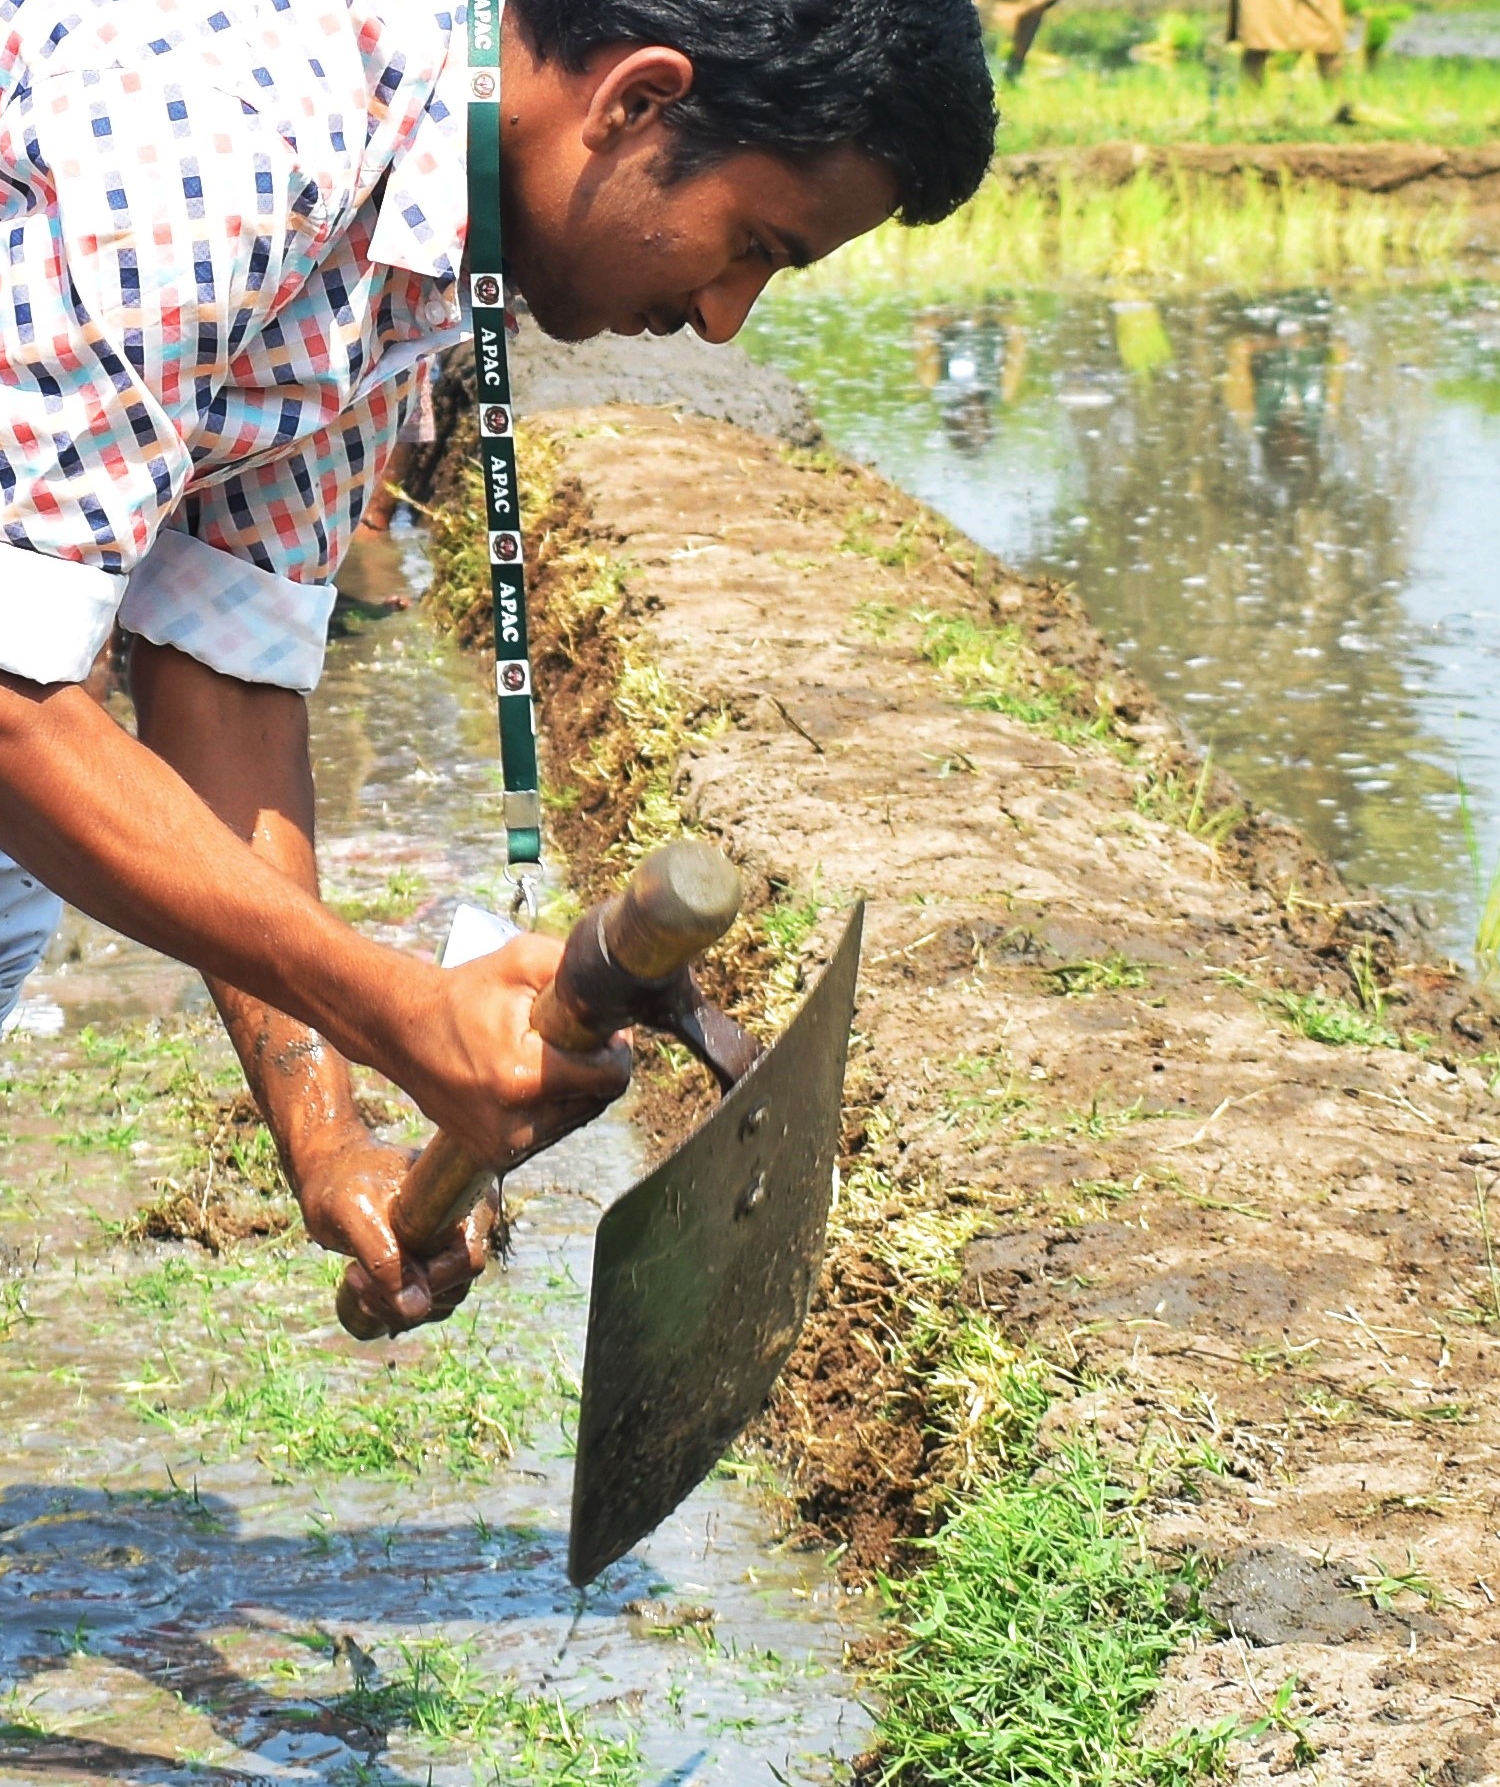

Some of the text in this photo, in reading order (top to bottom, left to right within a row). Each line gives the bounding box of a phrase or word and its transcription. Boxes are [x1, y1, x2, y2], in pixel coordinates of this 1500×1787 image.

[481, 327, 500, 386] APAC
[490, 455, 510, 514] APAC
[500, 581, 520, 643] APAC
